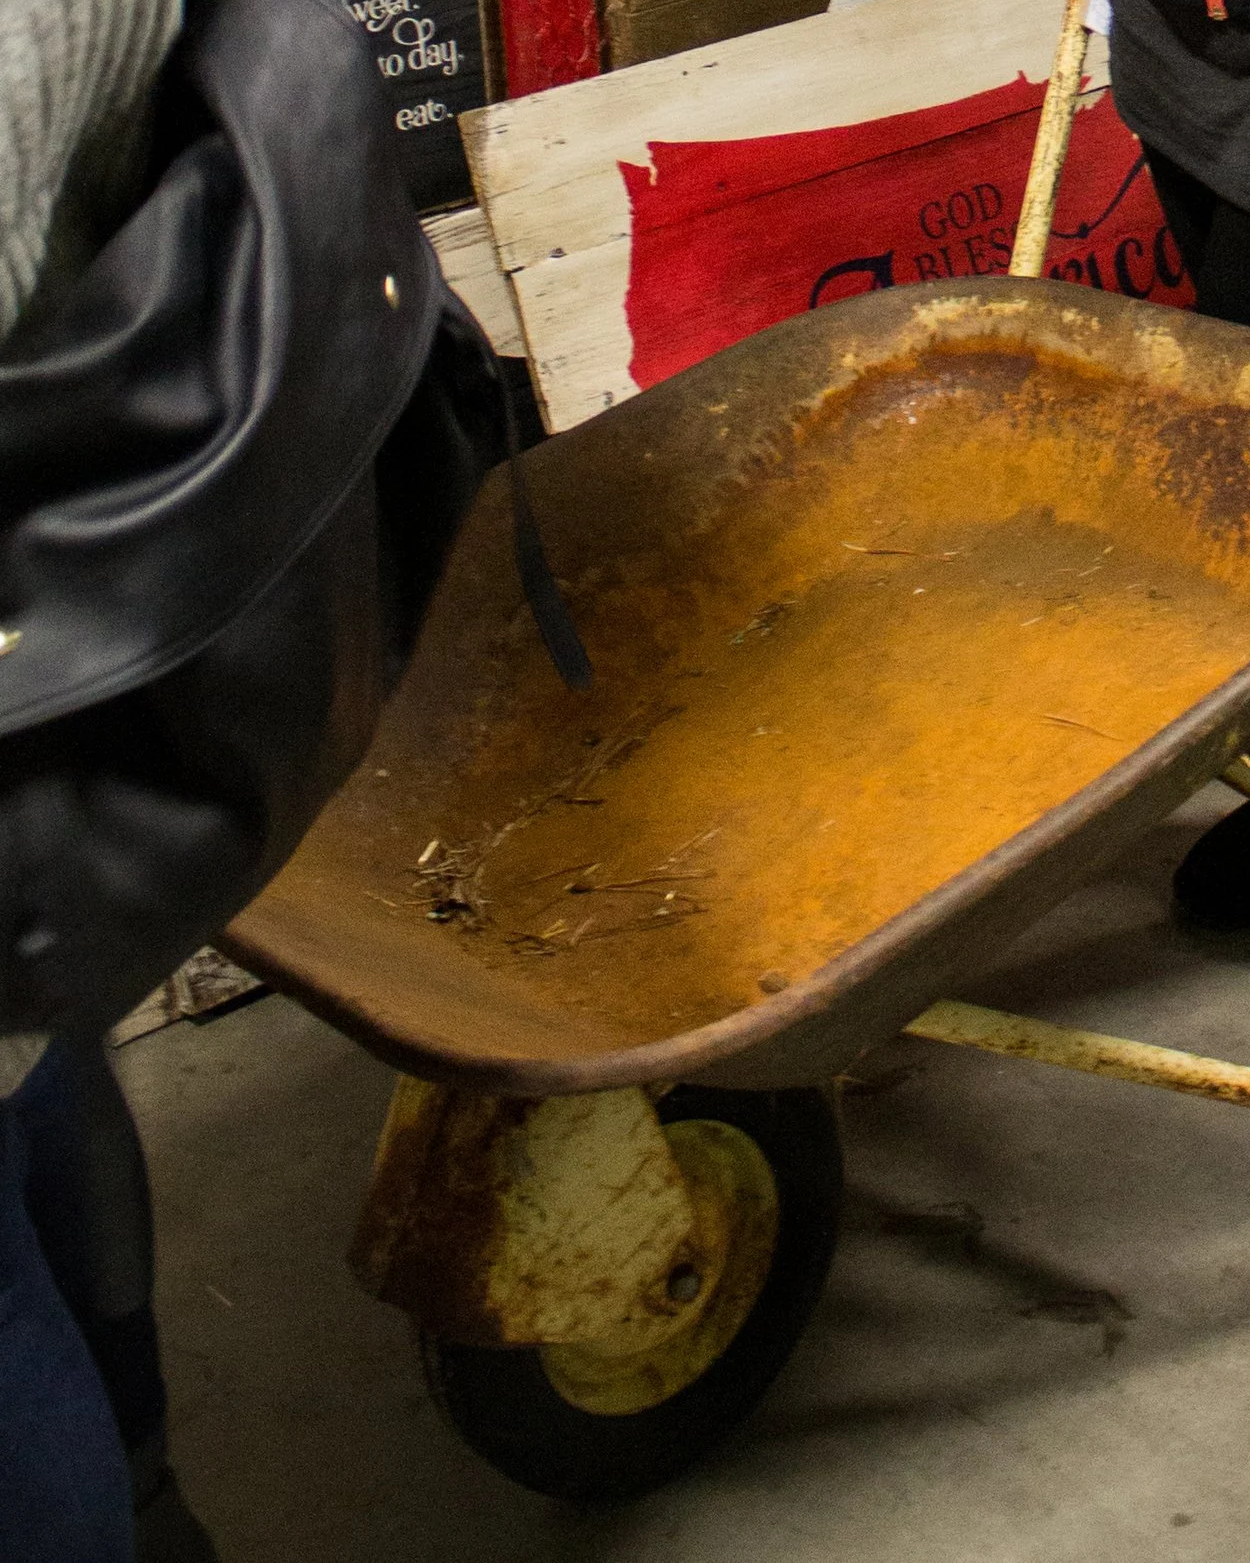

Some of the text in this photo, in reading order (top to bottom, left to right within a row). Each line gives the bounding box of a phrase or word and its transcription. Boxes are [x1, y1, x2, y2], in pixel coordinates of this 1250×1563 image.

[392, 17, 464, 75] day.
[919, 182, 1003, 239] GOD
[913, 222, 1018, 281] BLES
